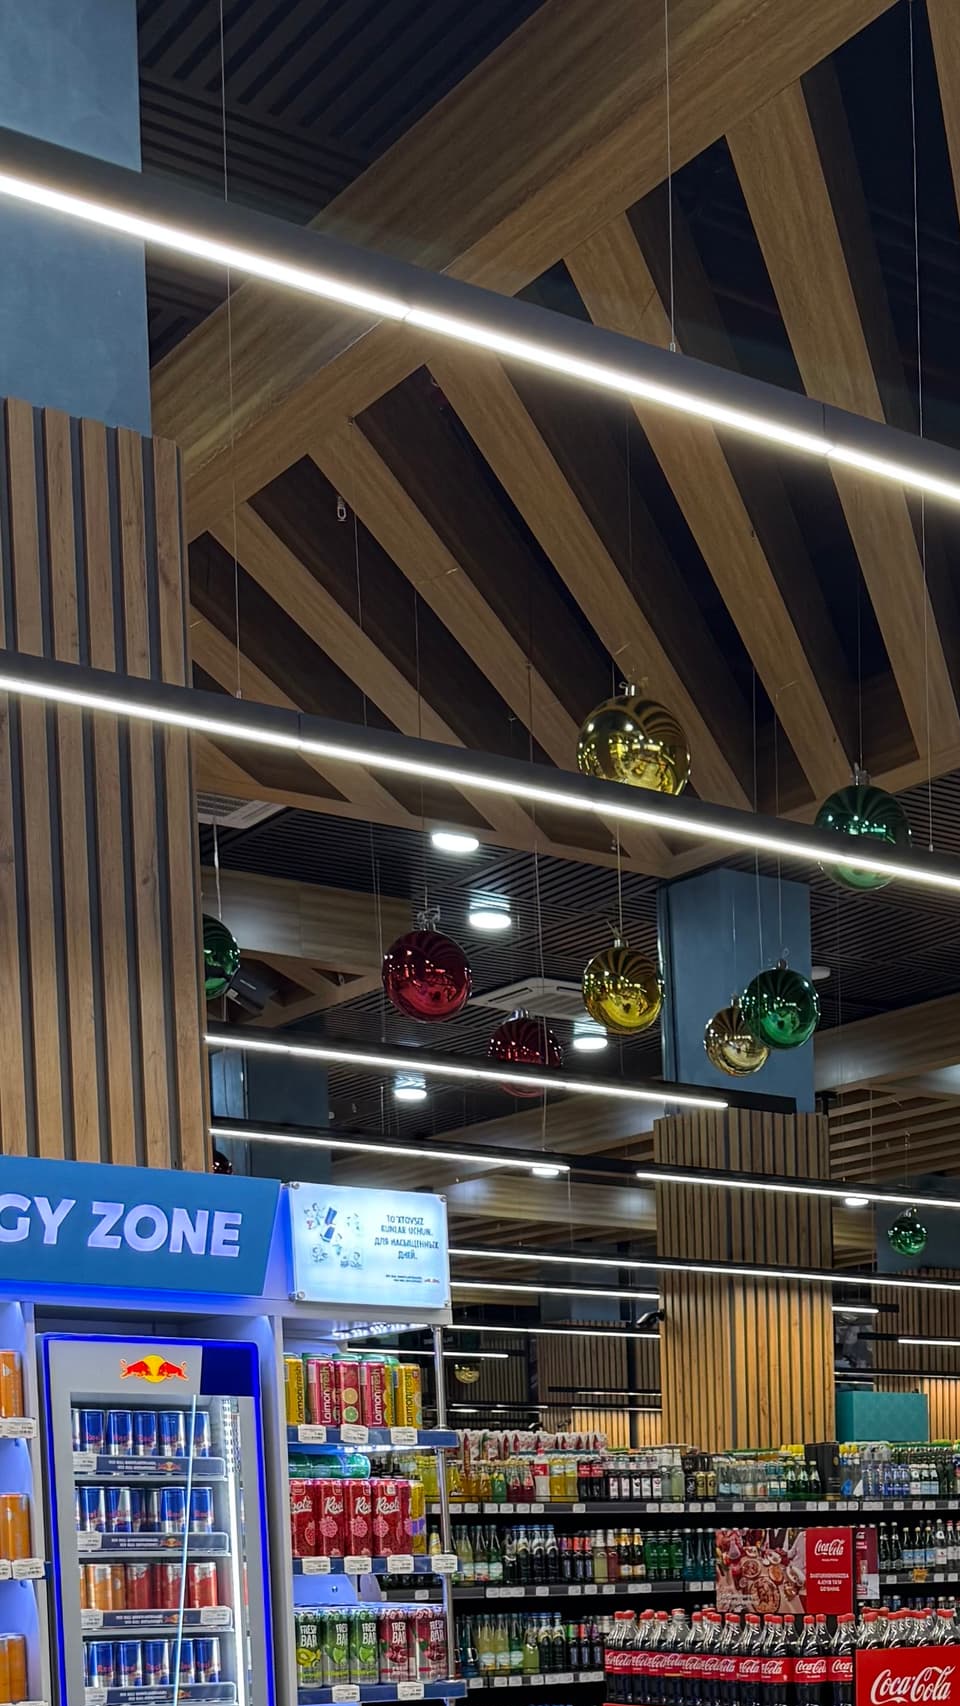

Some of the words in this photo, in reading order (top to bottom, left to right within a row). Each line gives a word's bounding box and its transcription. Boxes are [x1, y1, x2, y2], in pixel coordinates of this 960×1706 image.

[87, 1201, 243, 1258] ZONE
[814, 1538, 846, 1556] Coca-Cola
[795, 1660, 826, 1674] Coca-Col
[870, 1665, 956, 1705] Coca-Cola
